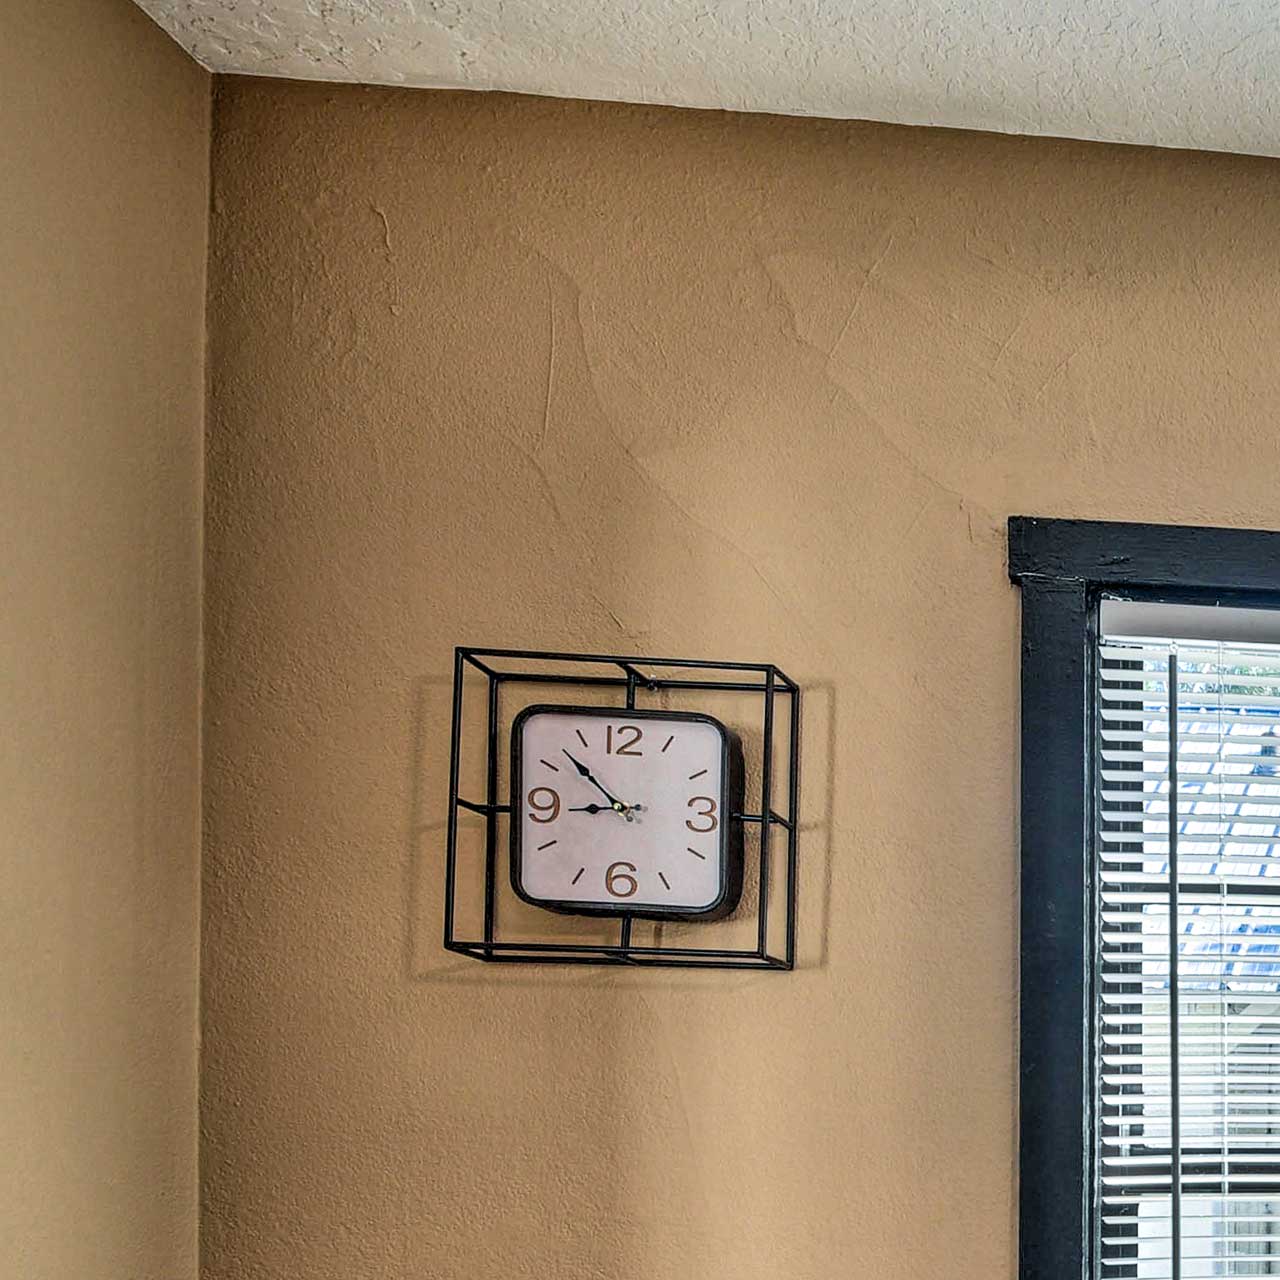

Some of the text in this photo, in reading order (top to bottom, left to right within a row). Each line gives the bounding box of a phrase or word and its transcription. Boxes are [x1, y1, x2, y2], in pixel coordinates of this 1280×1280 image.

[605, 725, 643, 757] 12
[527, 786, 561, 824] 9
[685, 796, 718, 833] 3
[604, 861, 638, 898] 6
